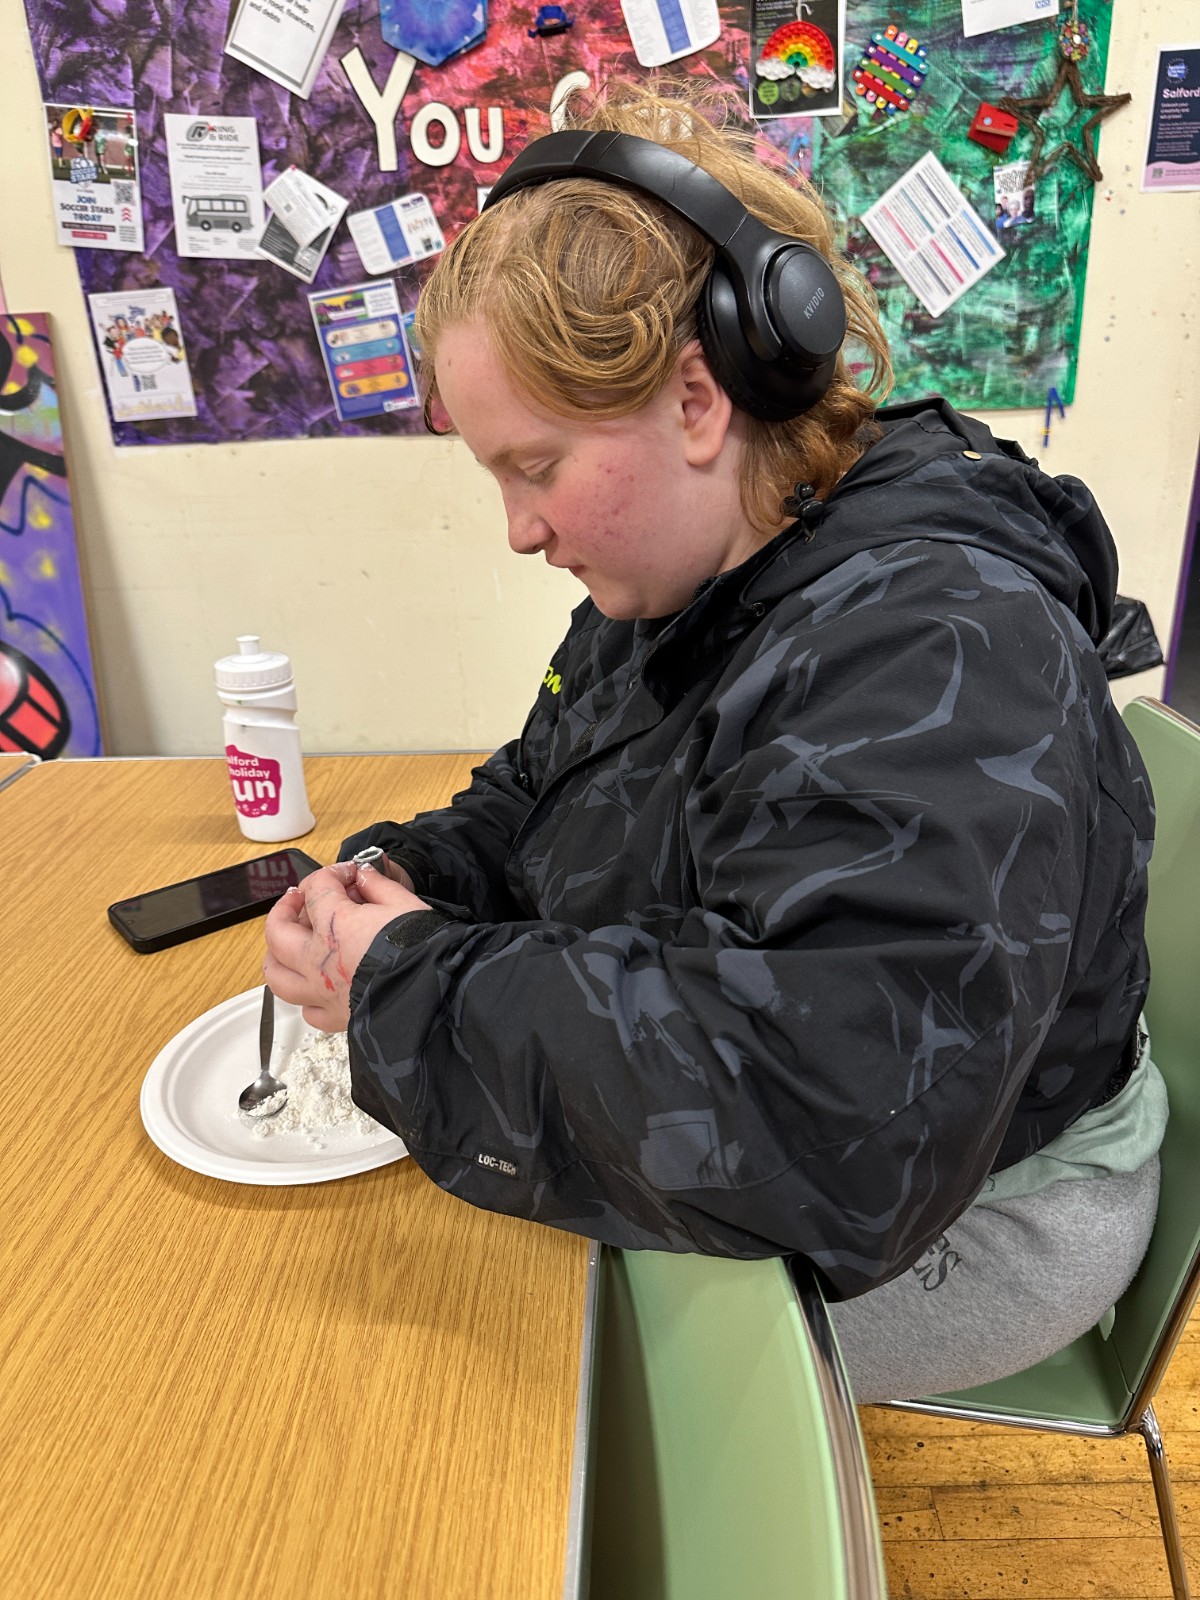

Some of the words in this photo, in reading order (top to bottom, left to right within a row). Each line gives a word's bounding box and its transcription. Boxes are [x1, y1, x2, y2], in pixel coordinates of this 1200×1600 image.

[249, 2, 262, 11] and
[1162, 86, 1200, 99] Salford
[218, 133, 239, 142] RIDE
[77, 195, 96, 204] JOIN
[90, 205, 114, 214] STARS
[803, 287, 825, 320] KVIDIO
[232, 779, 277, 802] un
